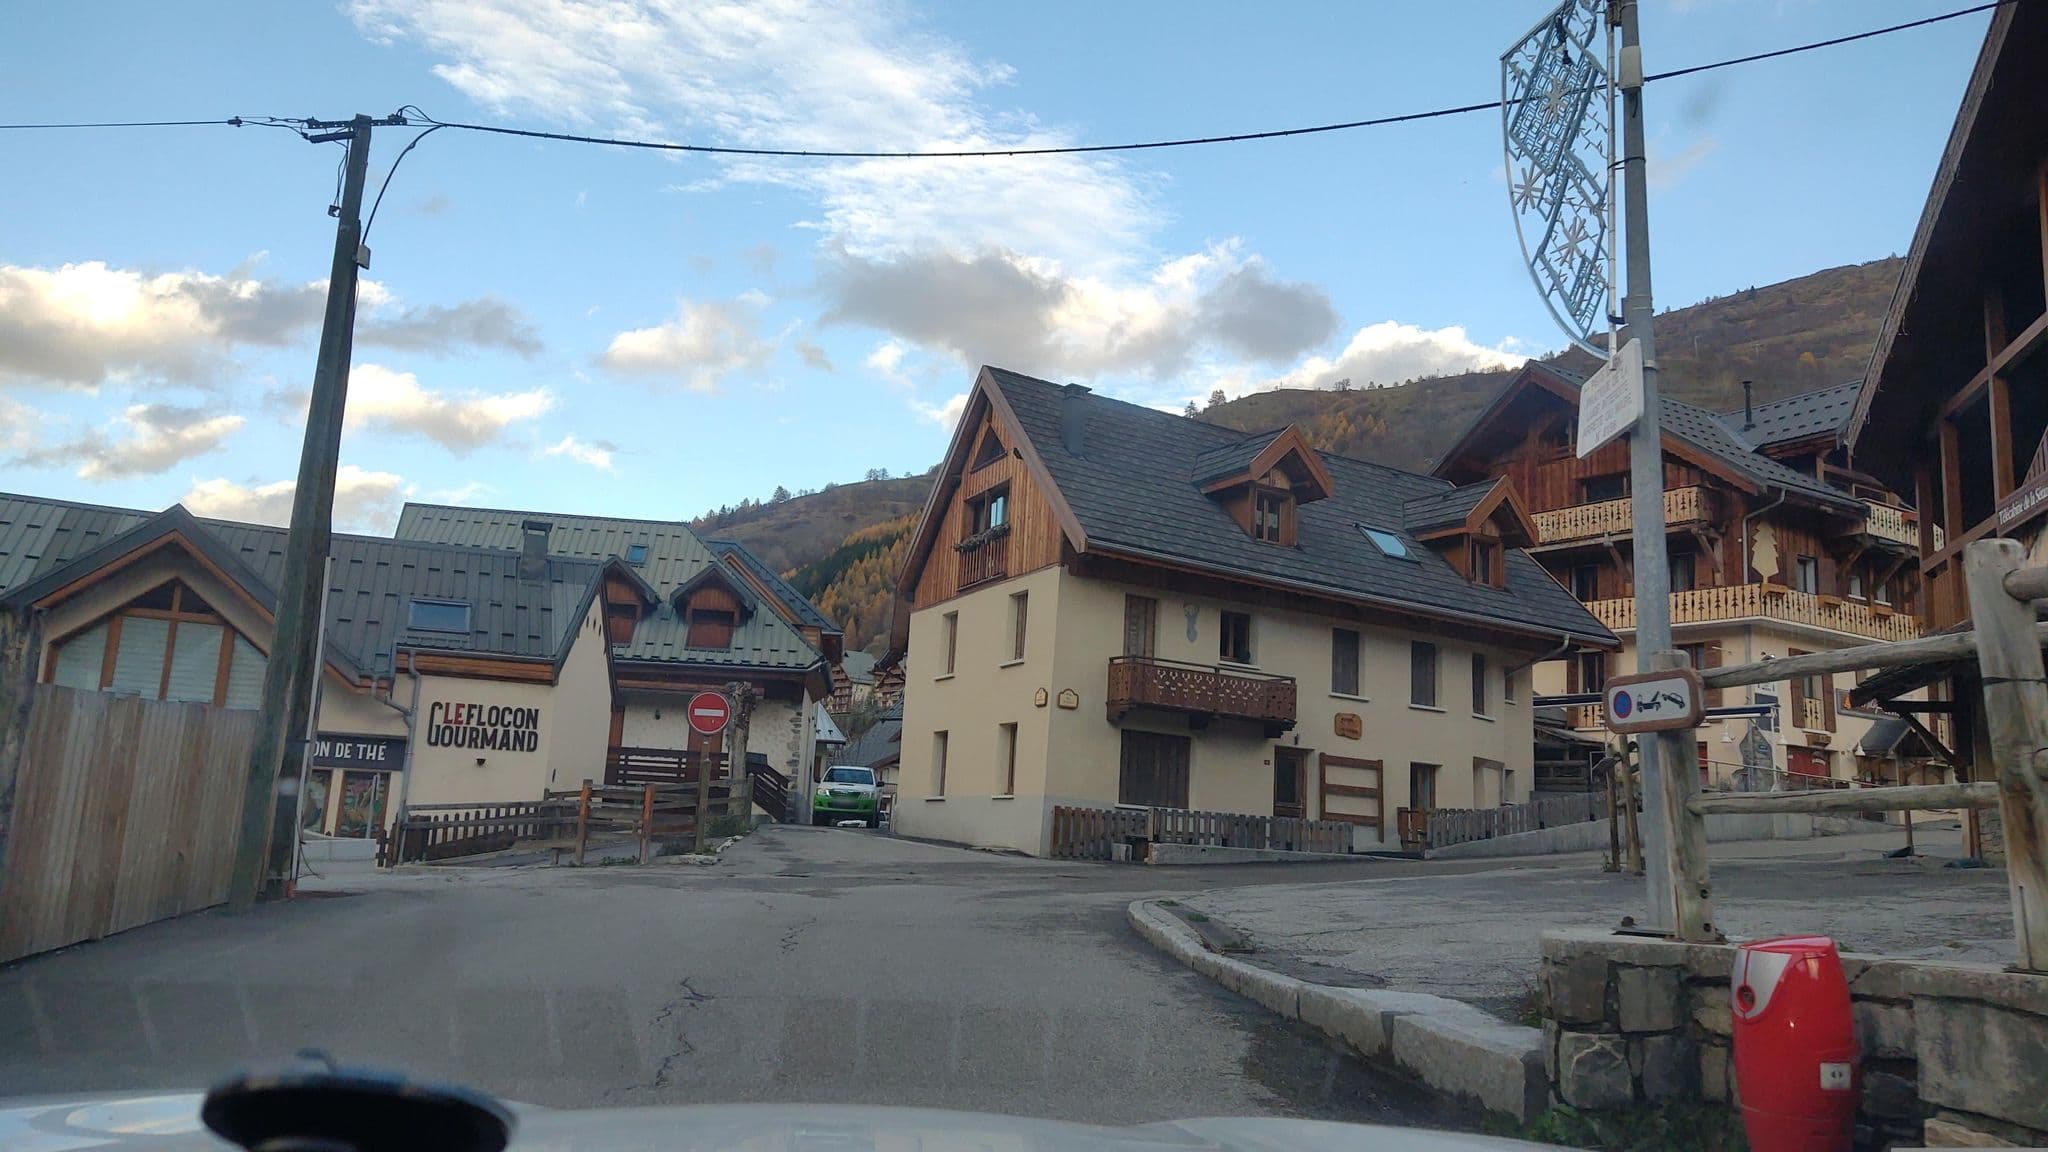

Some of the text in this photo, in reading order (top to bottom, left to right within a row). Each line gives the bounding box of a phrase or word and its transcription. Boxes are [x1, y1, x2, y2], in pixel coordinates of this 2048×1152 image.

[427, 702, 538, 752] GOURMAND
[335, 742, 352, 758] DE
[356, 741, 387, 760] THÉ
